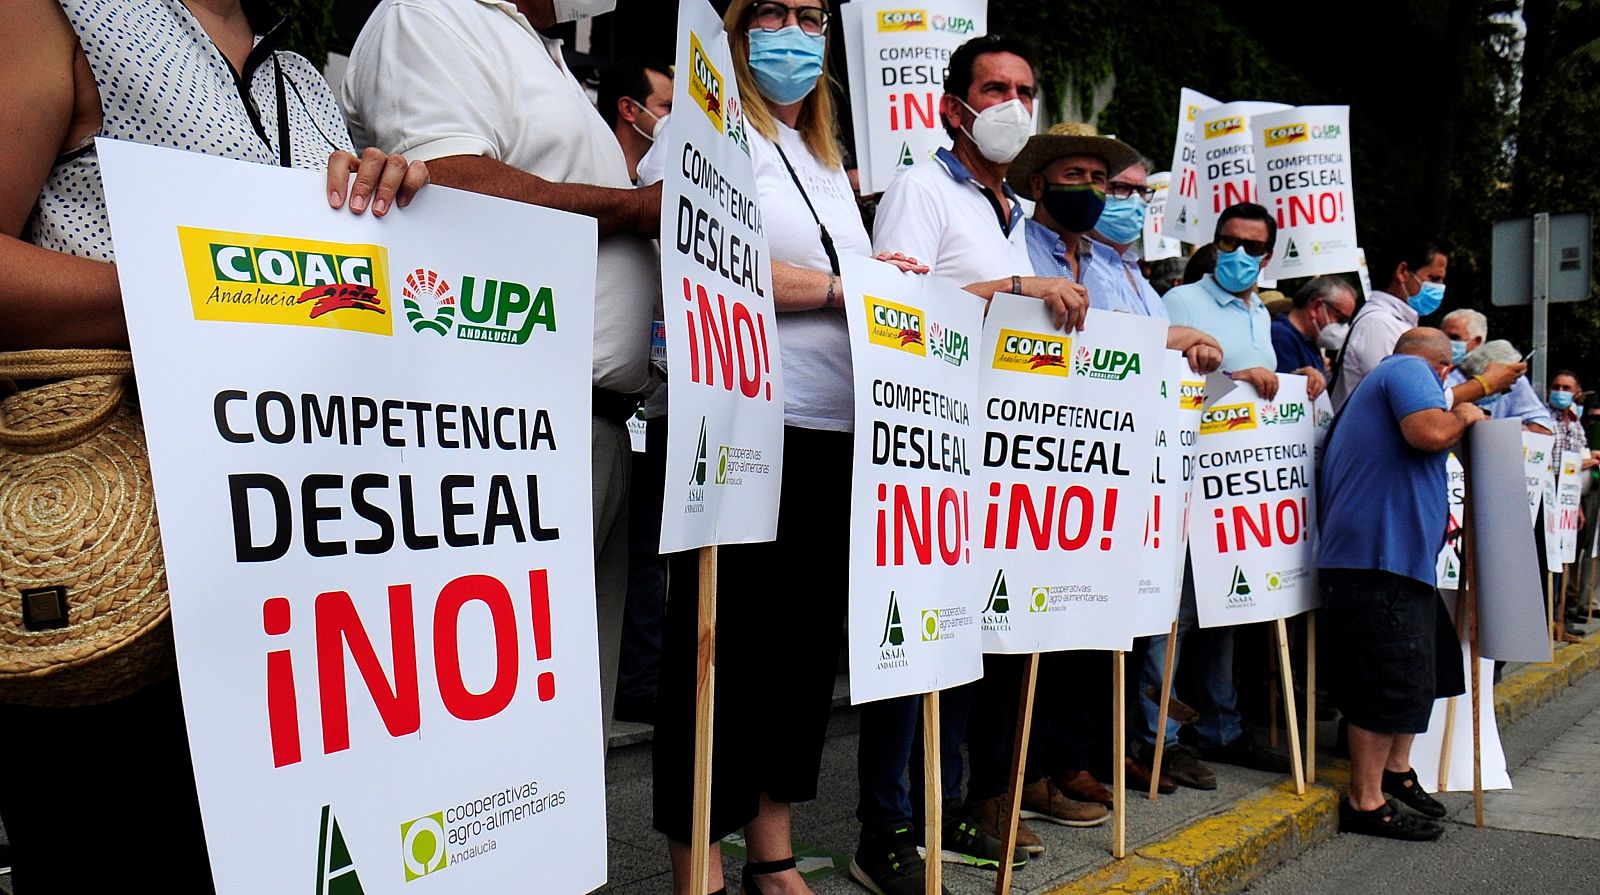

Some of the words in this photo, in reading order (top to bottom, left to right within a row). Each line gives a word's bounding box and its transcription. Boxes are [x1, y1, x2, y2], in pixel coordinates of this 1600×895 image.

[948, 17, 974, 33] UPA
[880, 47, 951, 61] COMPETE
[694, 51, 720, 98] COAG
[889, 92, 946, 131] ¡N
[1208, 160, 1256, 180] DESL
[1269, 170, 1345, 192] DESLEAL
[682, 142, 763, 239] COMPETENCIA
[1213, 179, 1258, 213] ¡N
[1276, 191, 1344, 230] ¡NO!
[676, 194, 765, 298] DESLEAL
[216, 246, 372, 288] COAG
[460, 275, 557, 336] UPA
[873, 305, 920, 332] COAG
[459, 327, 518, 344] ANDALUCÍA
[683, 277, 772, 402] ¡NO!
[944, 328, 969, 362] UPA
[1005, 336, 1063, 357] COAG
[1093, 348, 1141, 376] UPA
[213, 389, 558, 451] COMPETENCIA
[872, 379, 970, 427] COMPETENCIA
[986, 398, 1135, 432] COMPETENCIA
[1202, 407, 1250, 423] COAG
[1280, 403, 1305, 422] UPA
[872, 420, 971, 476] DESLEAL
[983, 431, 1130, 476] DESLEAL
[1199, 443, 1308, 469] COMPETENCIA
[1202, 465, 1310, 499] DESLEAL
[227, 471, 561, 564] DESLEAL
[876, 483, 970, 567] ¡NO!
[983, 482, 1119, 551] ¡NO!
[1214, 497, 1308, 553] ¡NO!
[262, 568, 557, 769] ¡NO!
[880, 648, 905, 661] ASAJA
[446, 781, 538, 824] cooperativas
[448, 790, 566, 846] agro-alimentarias
